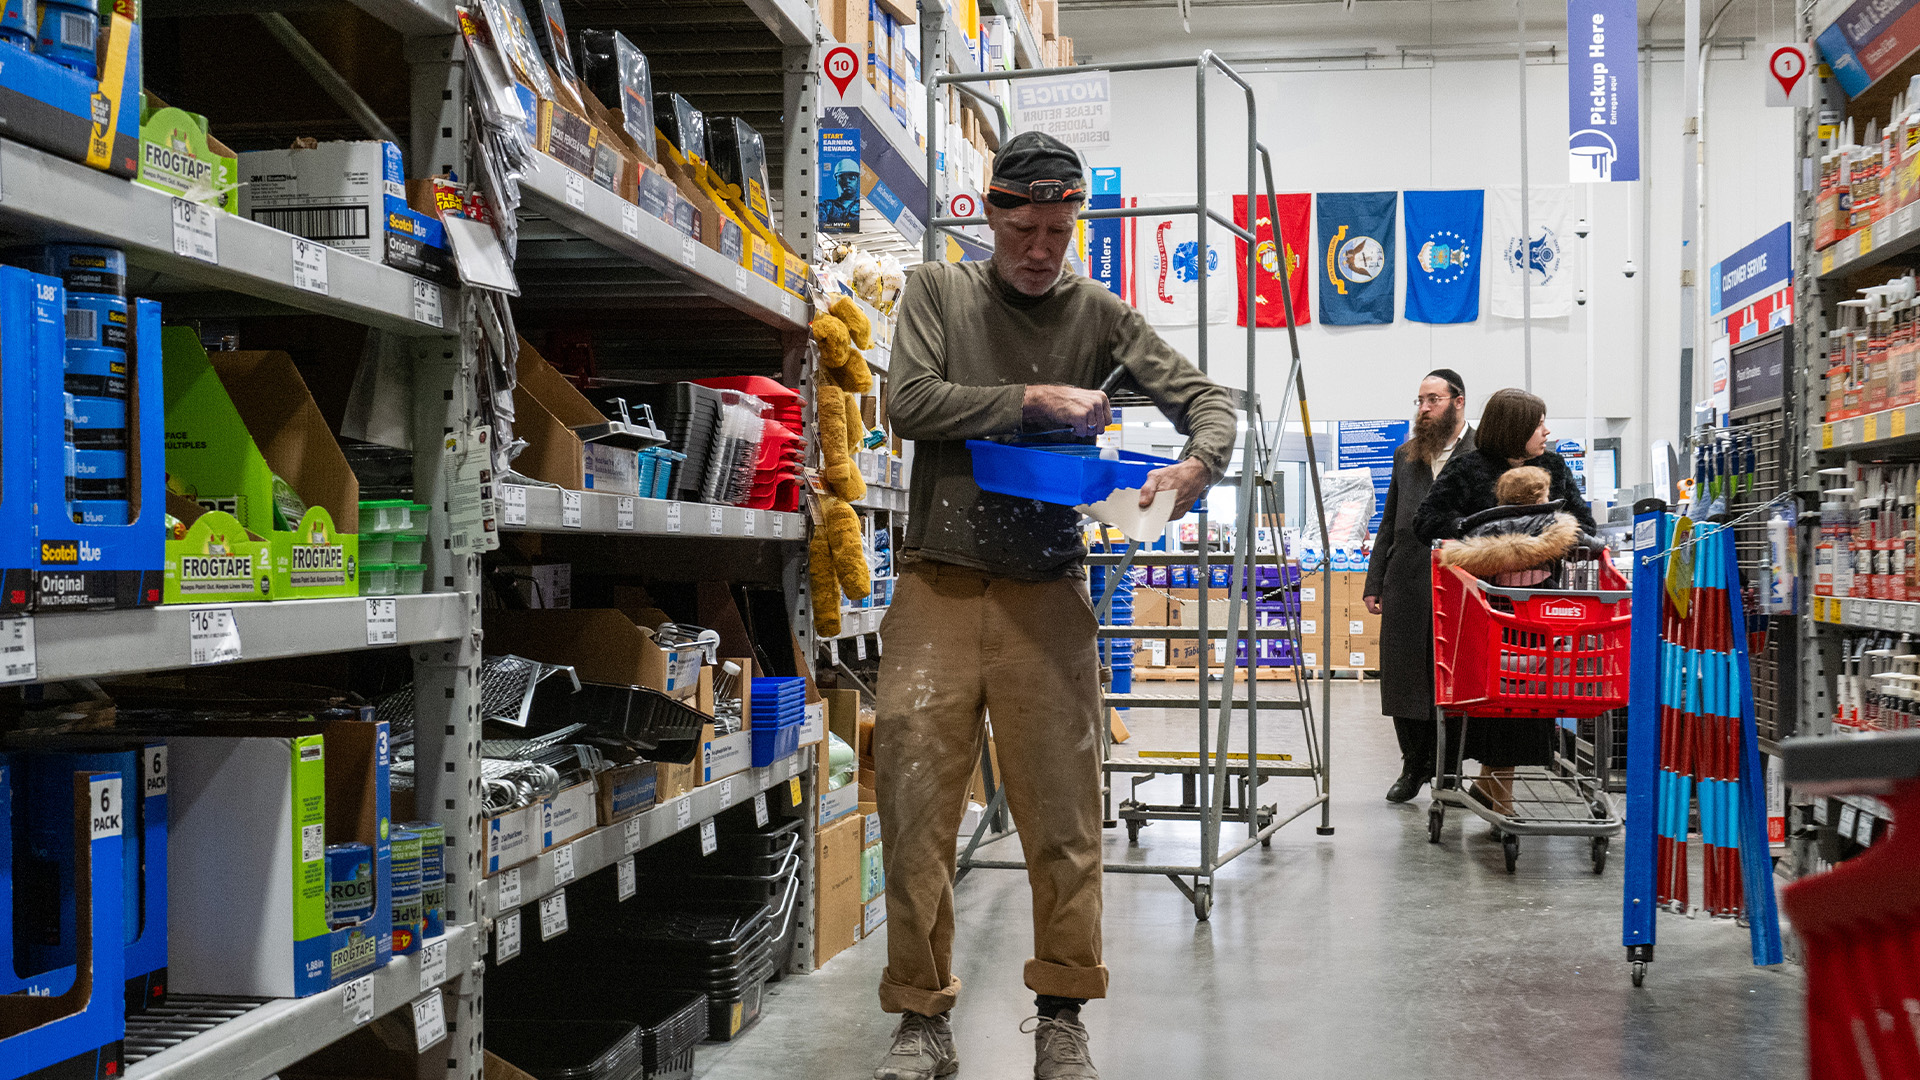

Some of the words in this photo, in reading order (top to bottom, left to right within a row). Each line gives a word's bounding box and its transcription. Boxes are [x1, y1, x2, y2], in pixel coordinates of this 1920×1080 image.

[1589, 13, 1605, 58] Here
[833, 60, 849, 71] 10
[1784, 60, 1791, 71] 1
[1590, 62, 1608, 125] Pickup
[219, 165, 228, 183] 2
[436, 192, 462, 202] FLEX
[437, 201, 462, 210] TAPE
[960, 203, 966, 211] 8
[390, 214, 413, 233] Scotch
[413, 220, 426, 237] blue
[389, 237, 417, 256] Original
[1101, 236, 1111, 278] Rollers
[1722, 265, 1747, 292] CUSTOMER
[1747, 252, 1767, 279] SERVICE
[84, 511, 104, 523] blue
[41, 543, 78, 562] Scotch
[79, 540, 101, 562] blue
[261, 548, 269, 565] 2
[293, 548, 343, 569] FROGTAPE
[183, 558, 251, 578] FROGTAPE
[41, 574, 85, 595] Original
[41, 595, 88, 605] MULTI-SURFACE
[1545, 605, 1581, 617] LOWE'S
[379, 731, 388, 755] 3
[153, 753, 162, 774] 6
[146, 776, 167, 790] PACK
[101, 787, 111, 812] 6
[94, 815, 120, 832] PACK
[332, 940, 374, 967] FROGTAPE
